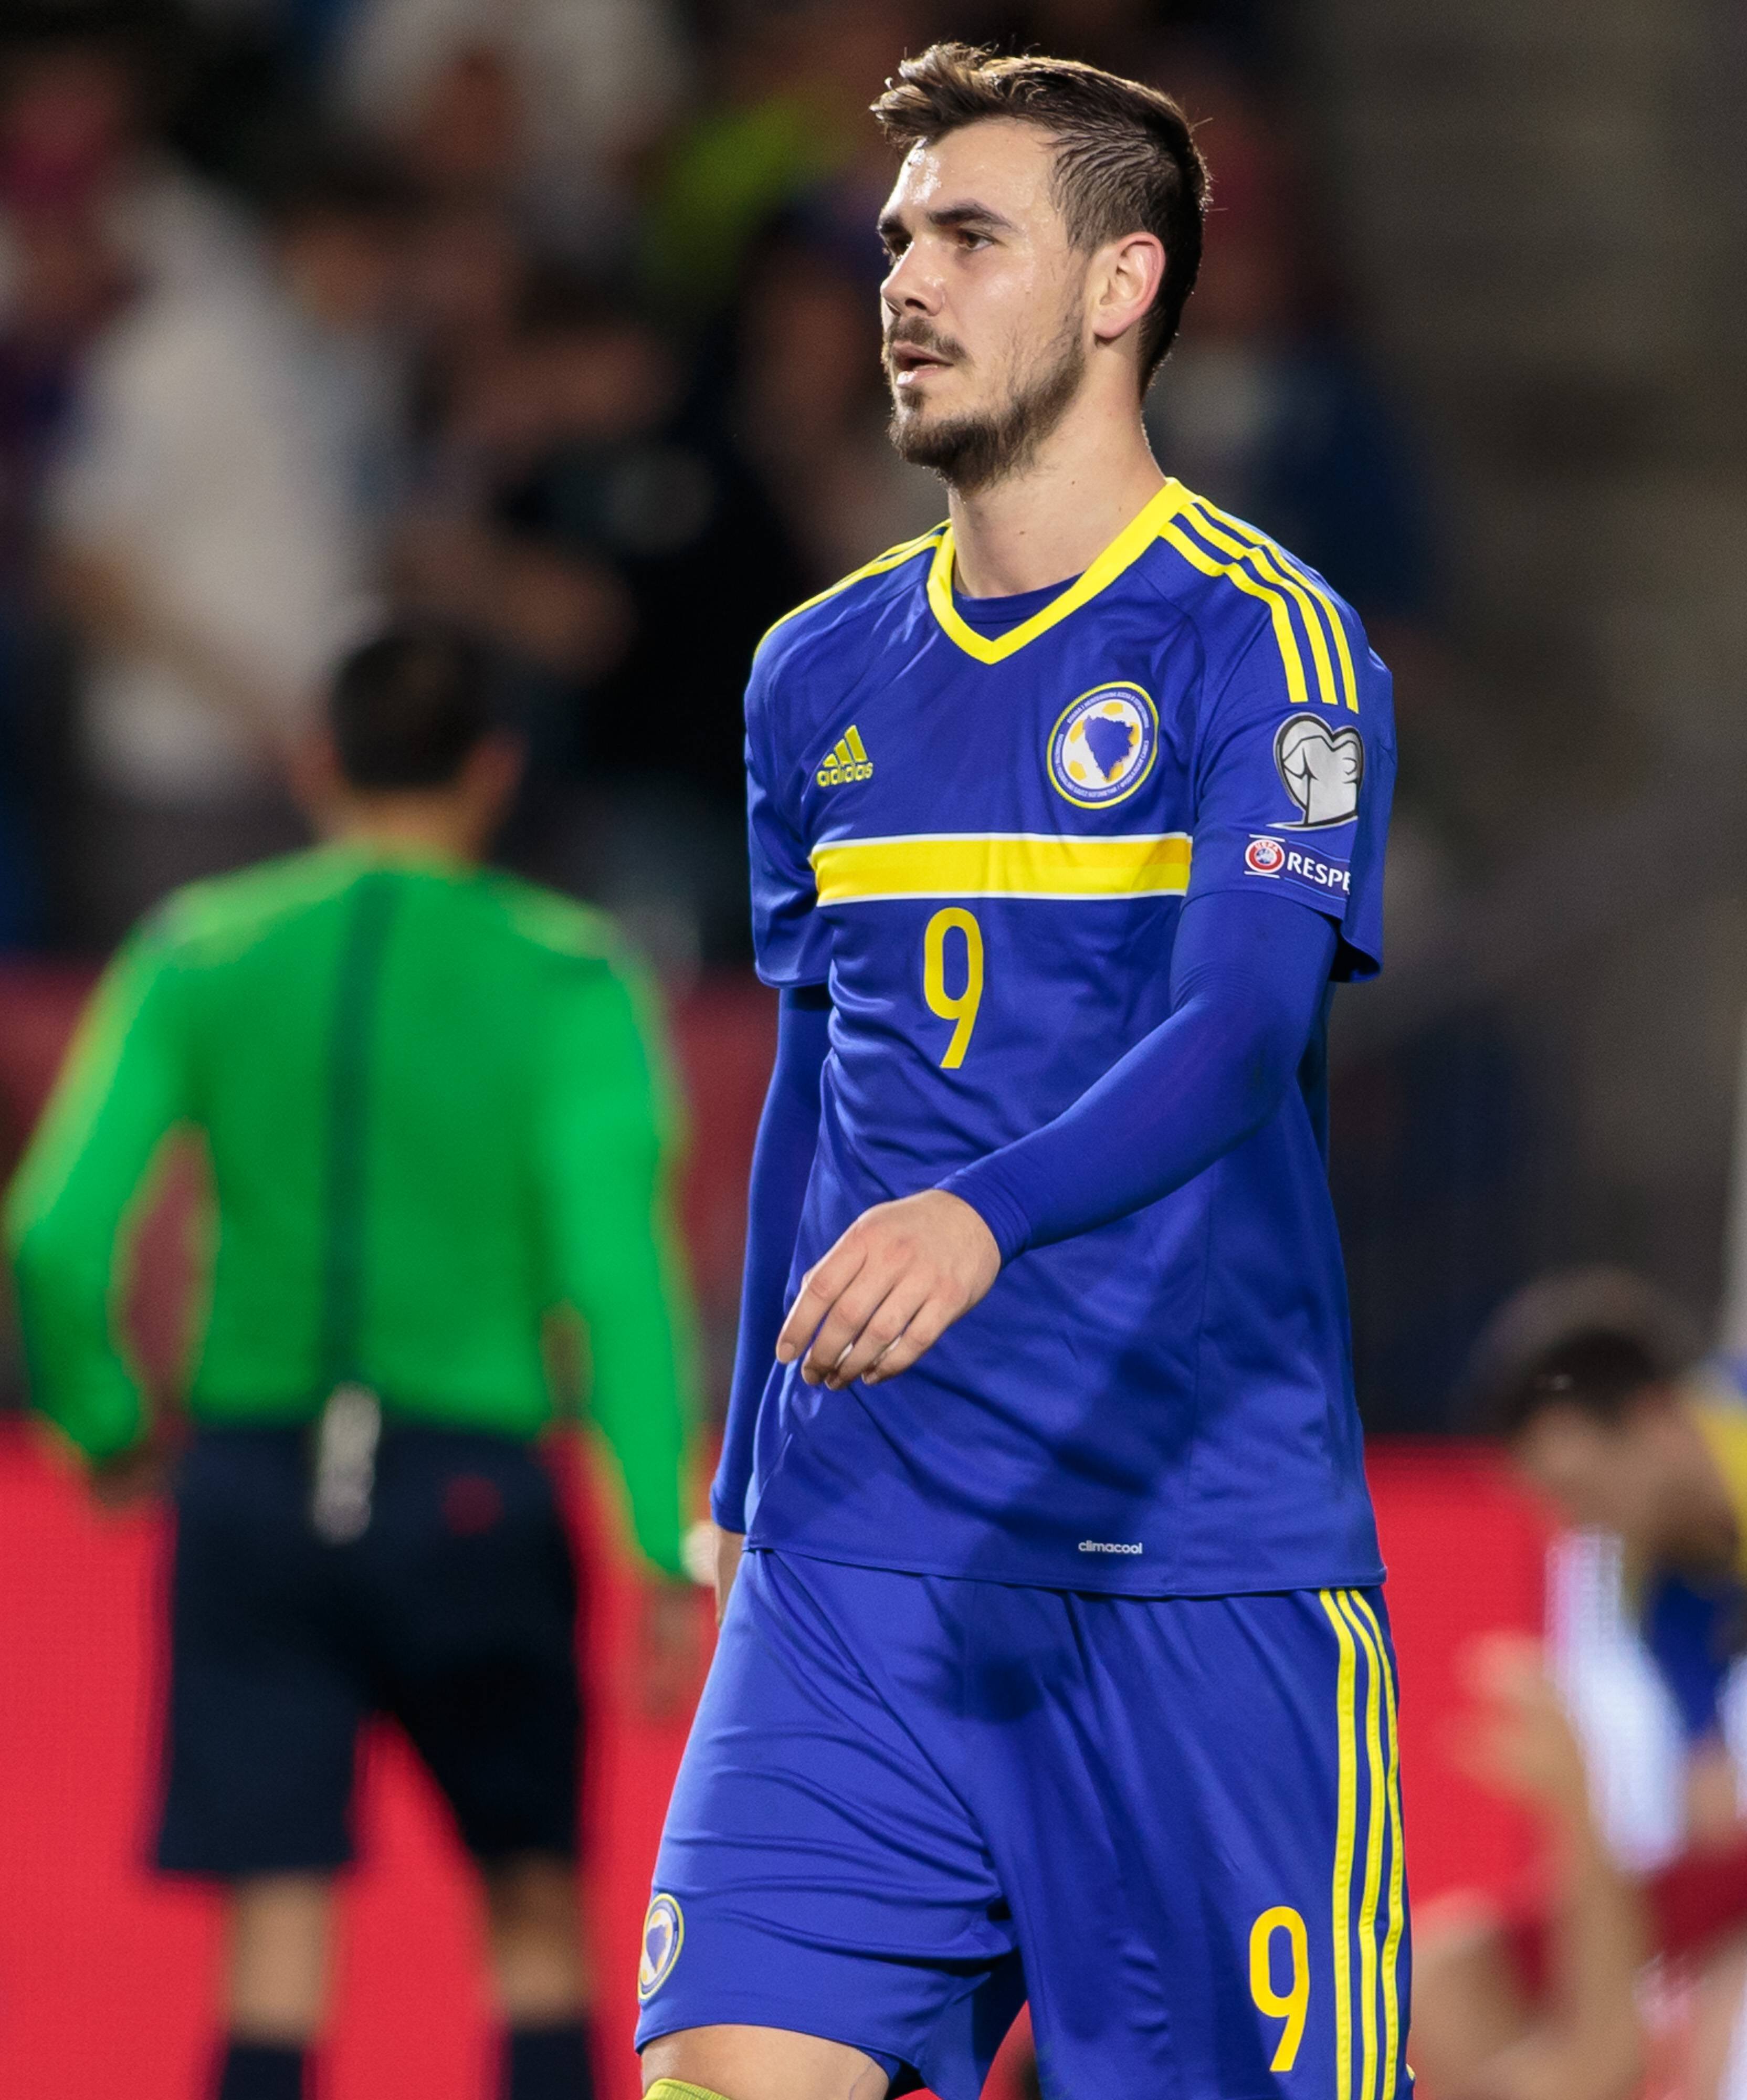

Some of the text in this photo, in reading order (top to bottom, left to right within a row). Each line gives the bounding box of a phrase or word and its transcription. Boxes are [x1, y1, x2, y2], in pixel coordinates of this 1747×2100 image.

[817, 762, 873, 786] adidas
[923, 907, 984, 1068] 9
[1078, 1540, 1143, 1554] climacool
[1249, 1906, 1310, 2072] 9
